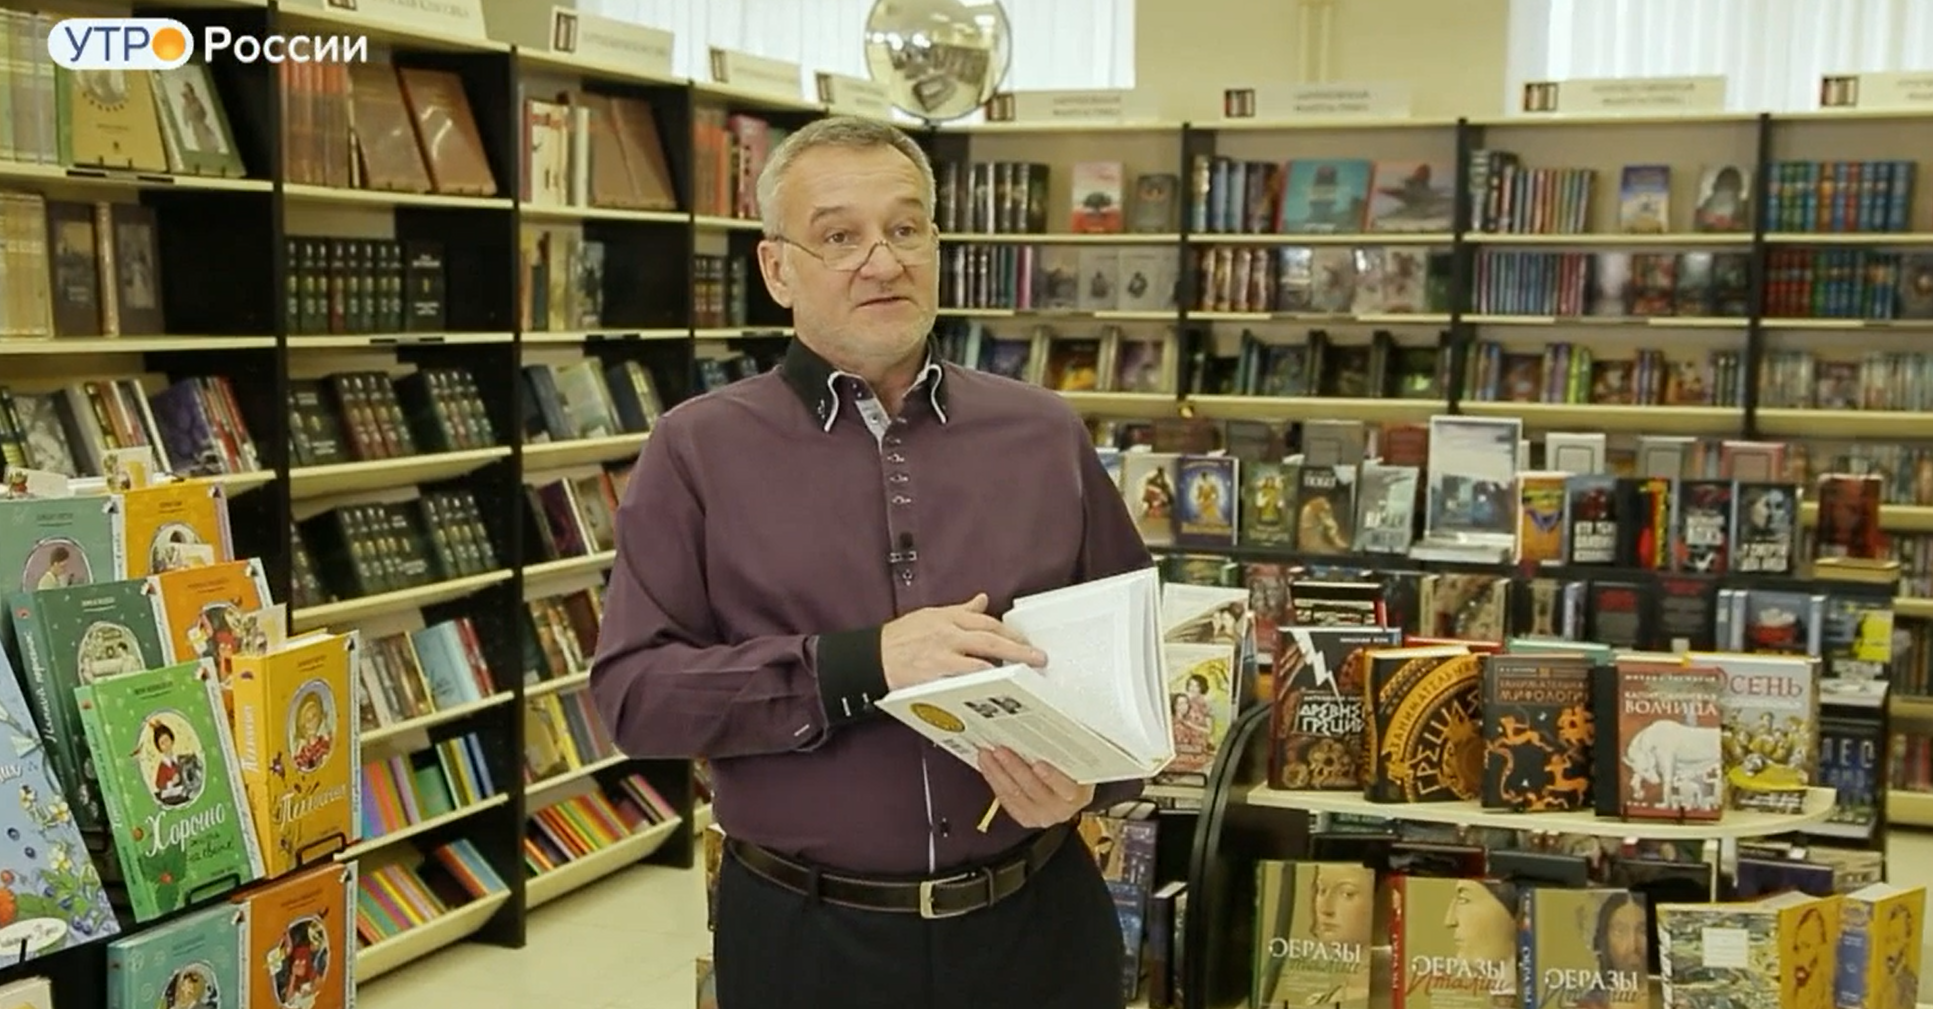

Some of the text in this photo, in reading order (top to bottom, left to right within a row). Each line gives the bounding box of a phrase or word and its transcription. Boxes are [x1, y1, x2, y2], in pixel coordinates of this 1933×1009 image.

[1624, 700, 1719, 717] ВОЛЧИЦА
[145, 802, 226, 858] Хорошо
[1268, 937, 1362, 963] ОБРАЗЫ
[1411, 955, 1506, 980] ОБРАЗЫ
[1544, 967, 1639, 993] ОБРАЗЫ
